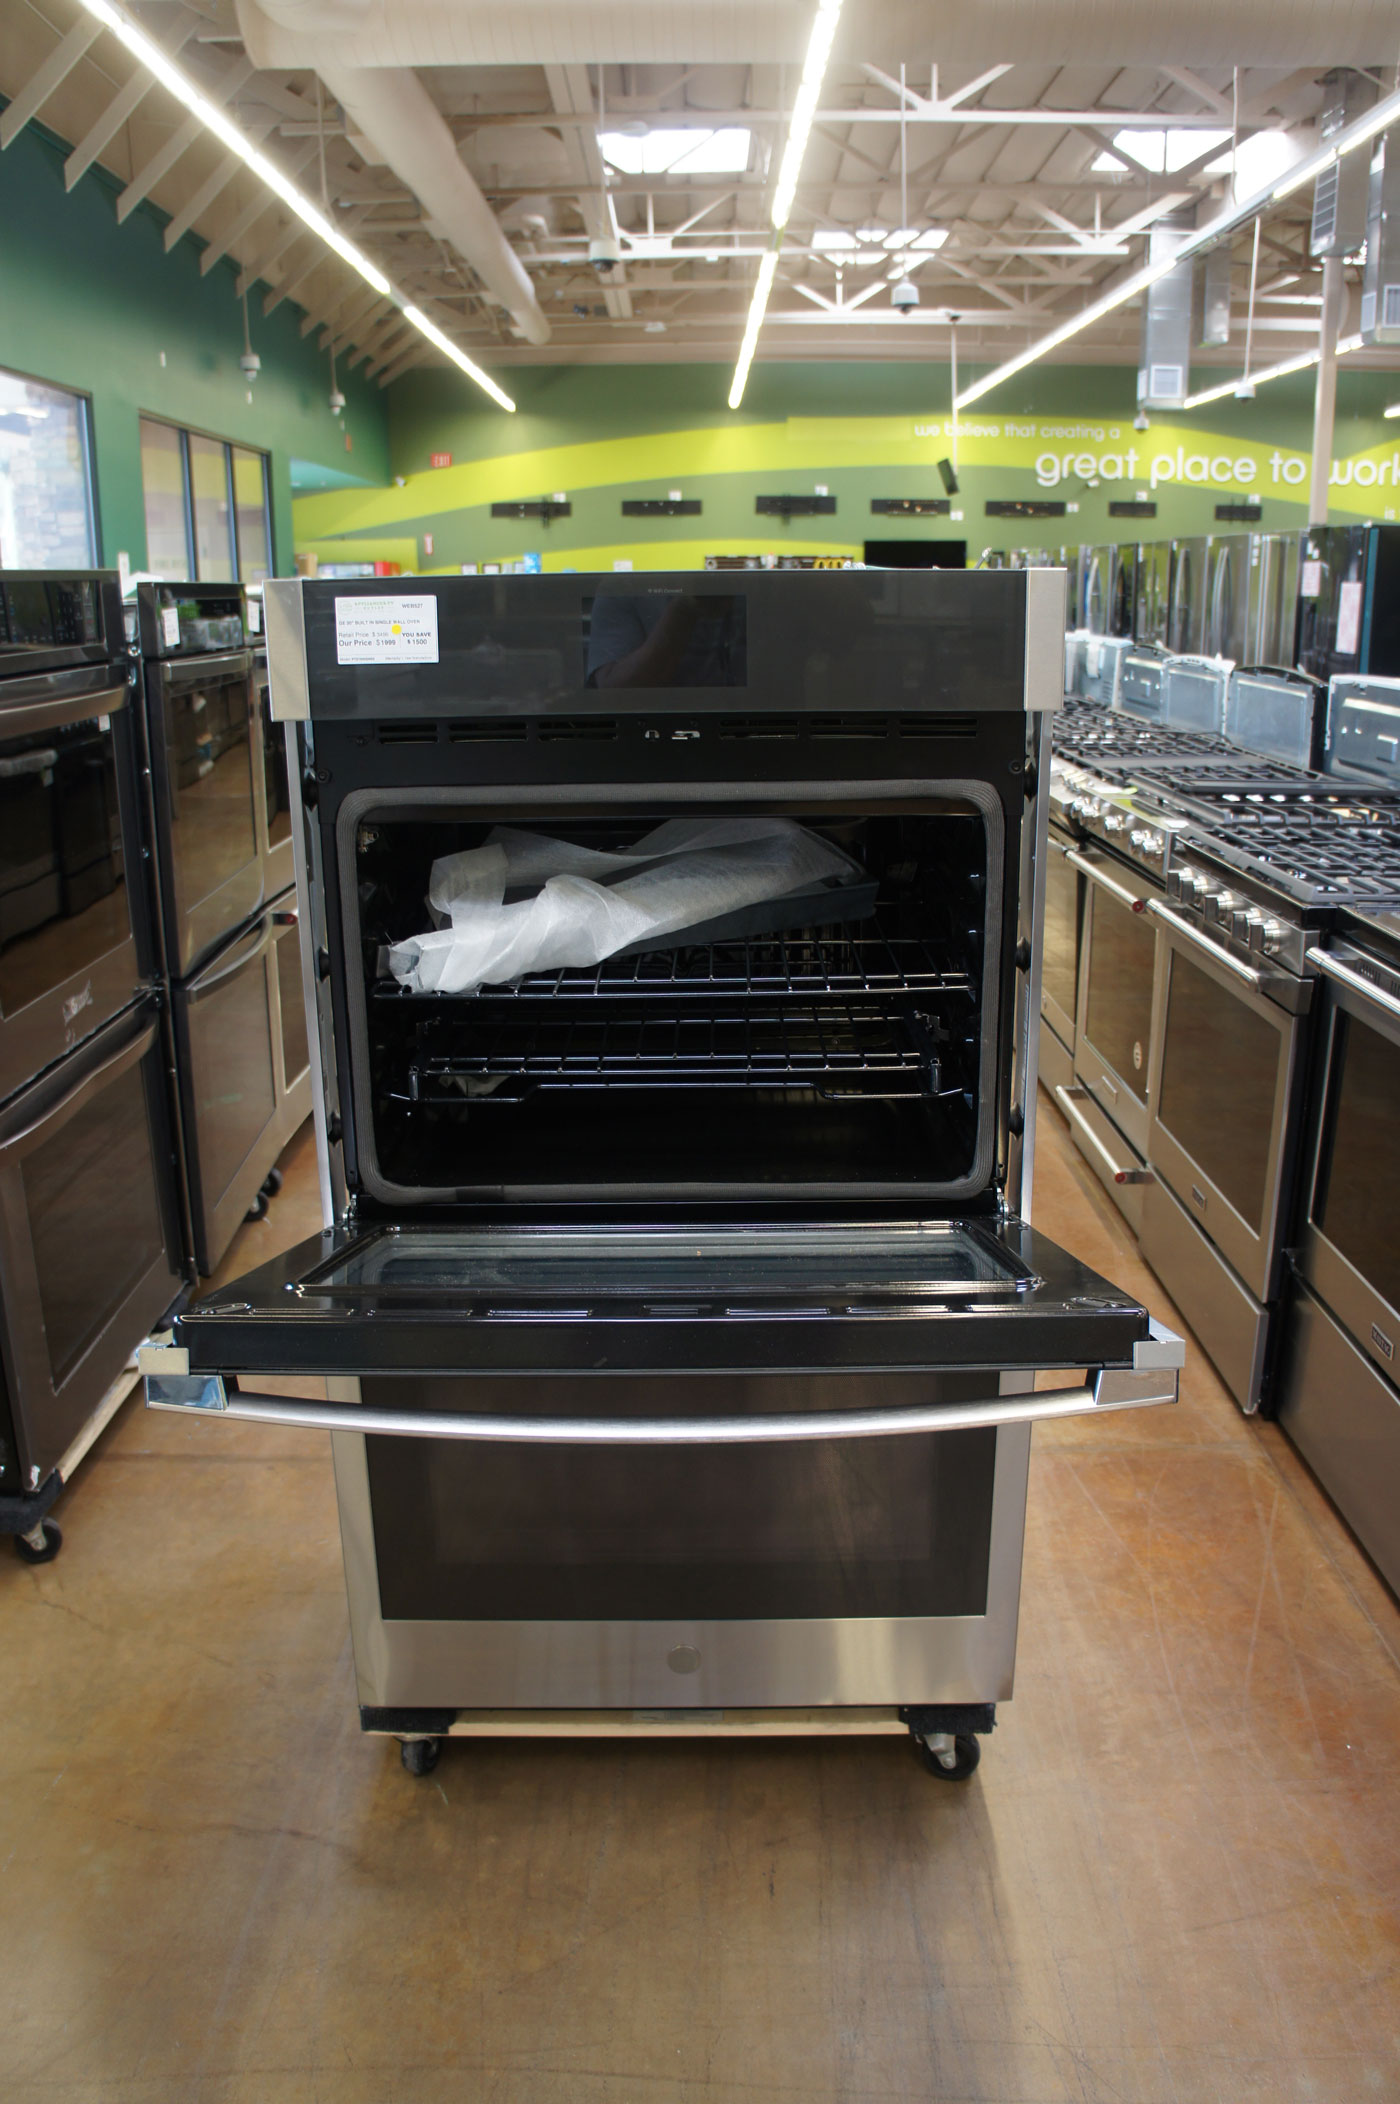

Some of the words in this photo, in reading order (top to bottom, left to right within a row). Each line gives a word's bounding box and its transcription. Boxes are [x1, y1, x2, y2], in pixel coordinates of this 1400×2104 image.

[914, 424, 940, 437] we
[944, 421, 1000, 437] believe
[1004, 422, 1035, 438] that
[1040, 423, 1104, 442] creating
[1109, 427, 1120, 439] a
[1035, 447, 1139, 487] great
[1149, 445, 1257, 489] place
[1269, 450, 1306, 484] to
[339, 639, 352, 647] Our
